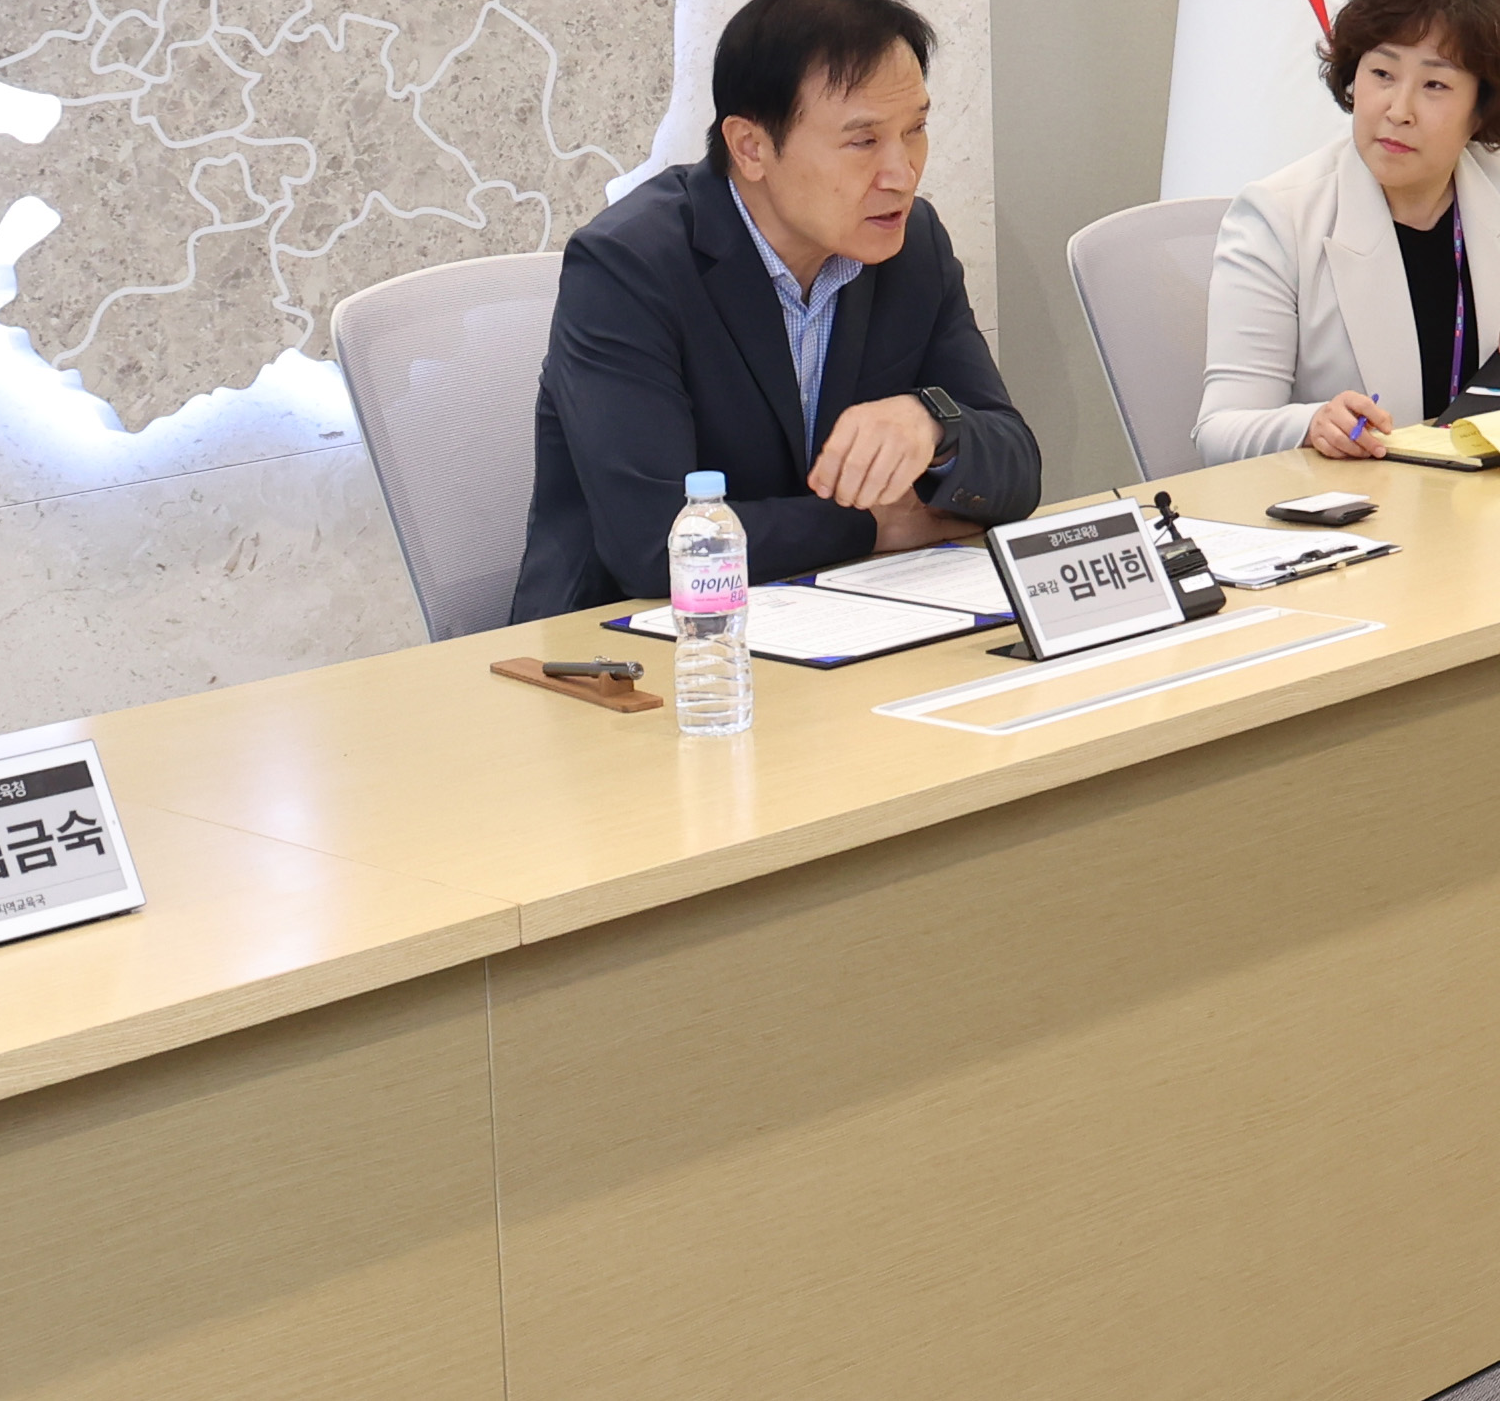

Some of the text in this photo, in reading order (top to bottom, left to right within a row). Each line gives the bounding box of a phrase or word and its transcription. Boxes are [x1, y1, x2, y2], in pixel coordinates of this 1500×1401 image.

[1048, 524, 1100, 547] 경기도교육청
[691, 574, 743, 593] 아이시스
[1060, 546, 1155, 602] 임태희
[1027, 579, 1060, 598] 교육감
